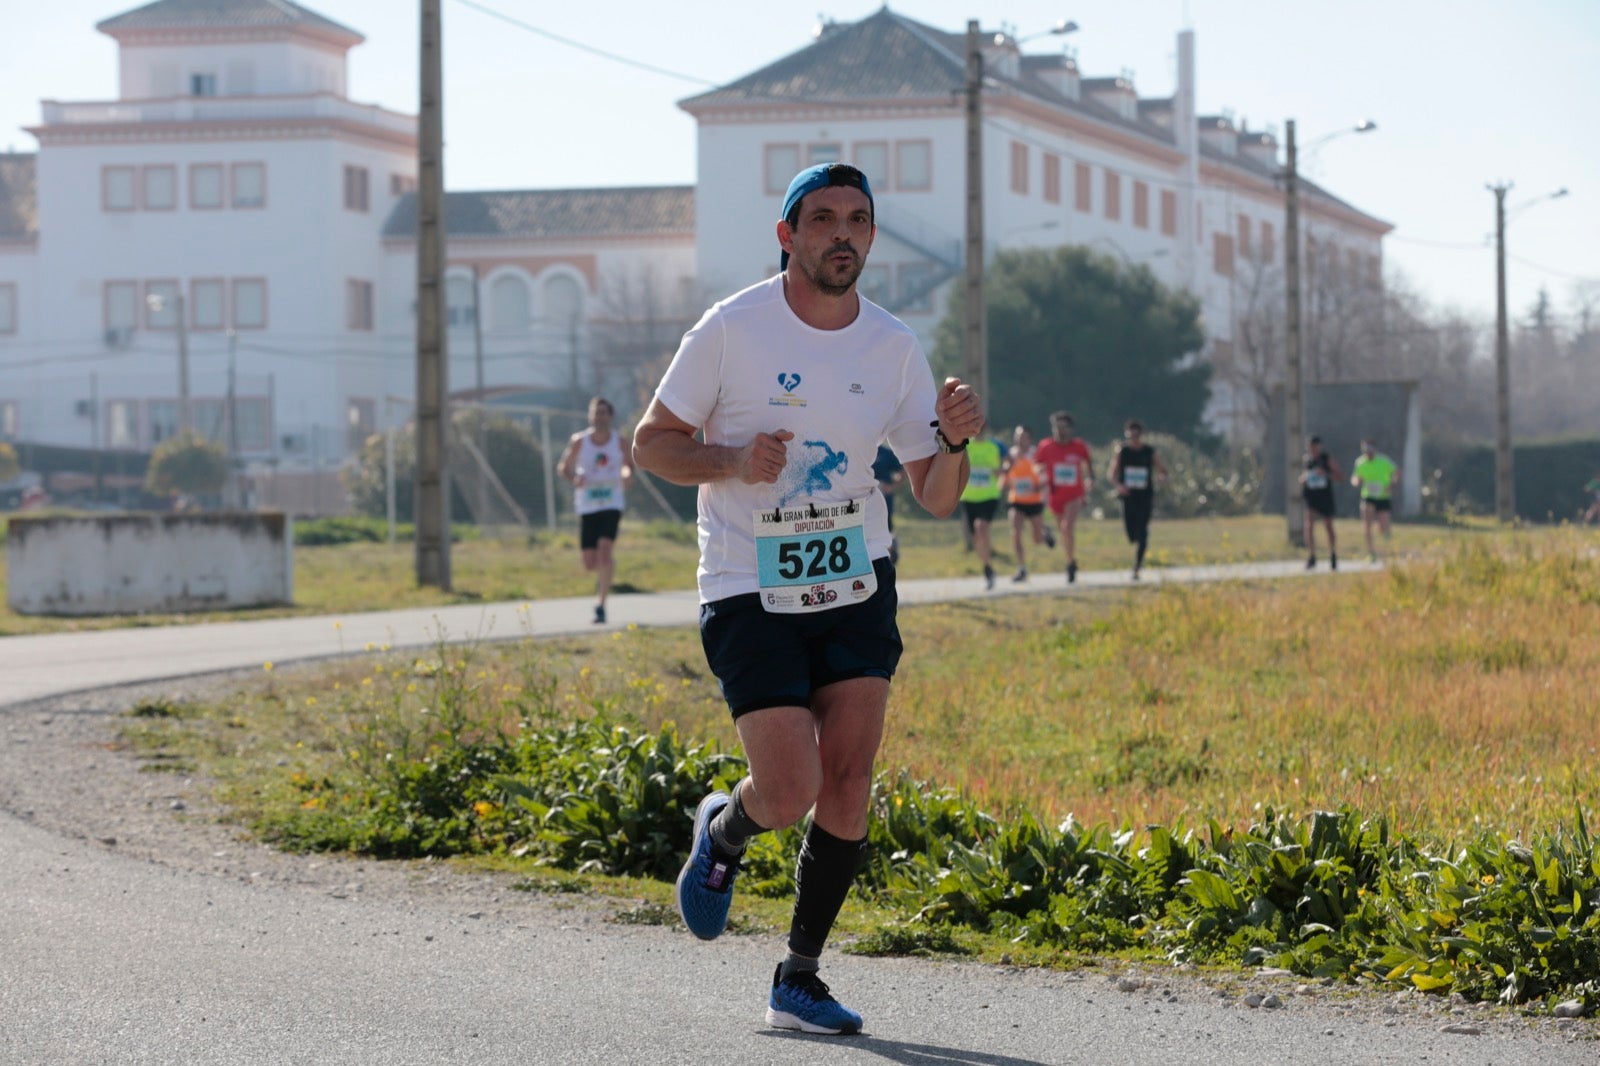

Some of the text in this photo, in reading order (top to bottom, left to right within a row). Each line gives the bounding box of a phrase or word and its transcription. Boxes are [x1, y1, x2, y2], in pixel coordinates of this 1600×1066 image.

[784, 510, 803, 522] GRAN
[831, 506, 840, 517] DE
[794, 518, 835, 533] DIPUTACIÓN
[778, 536, 851, 580] 528
